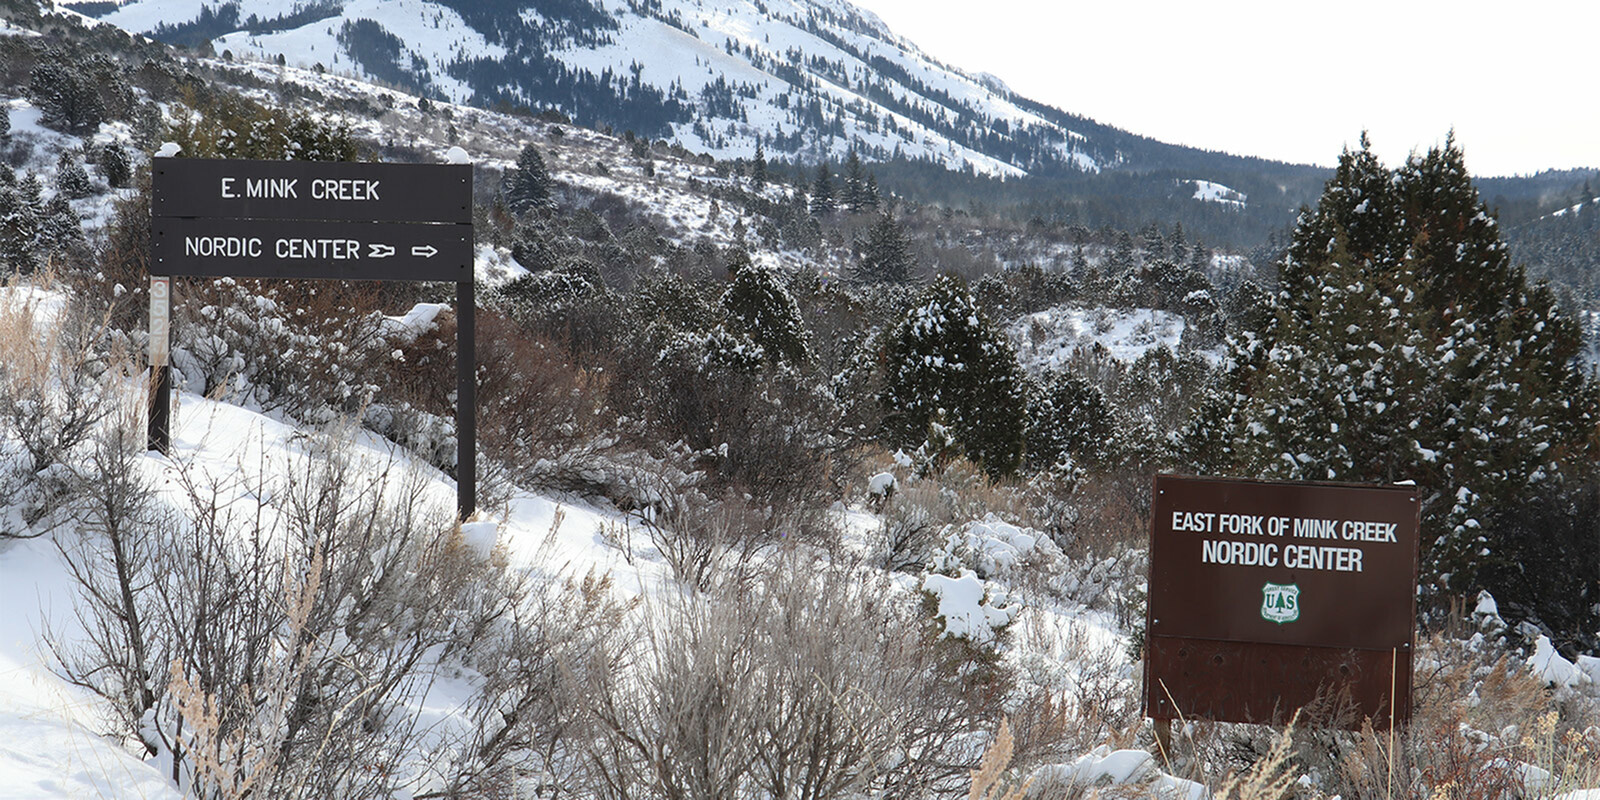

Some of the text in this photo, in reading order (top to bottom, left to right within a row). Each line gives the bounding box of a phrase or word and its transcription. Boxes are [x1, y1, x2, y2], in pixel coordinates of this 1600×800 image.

[246, 178, 298, 199] MINK
[311, 179, 380, 201] CREEK
[185, 236, 360, 261] NORDIC CENTER
[1172, 511, 1398, 543] EAST FORK OF MINK CREEK
[1202, 540, 1364, 572] NORDIC CENTER
